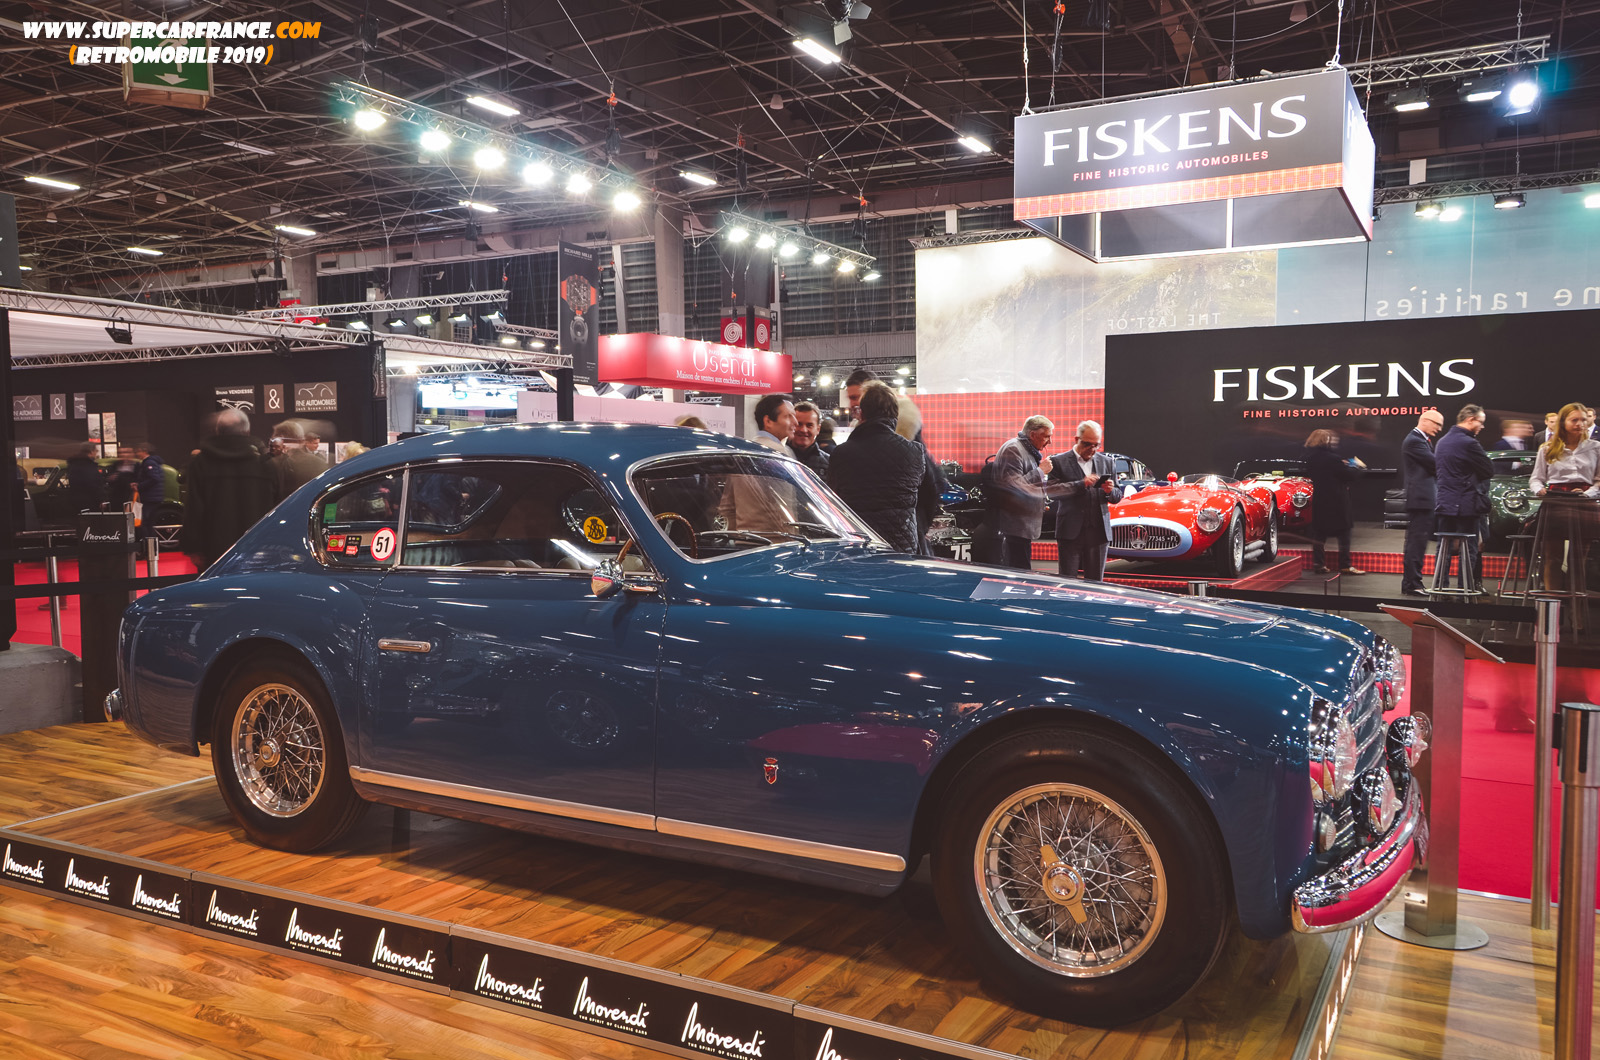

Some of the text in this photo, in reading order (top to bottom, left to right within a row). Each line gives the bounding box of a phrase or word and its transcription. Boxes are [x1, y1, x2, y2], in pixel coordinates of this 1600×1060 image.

[1043, 95, 1307, 166] FISKENS
[1073, 150, 1269, 182] FINE HISTORIC AUTOMOBILES
[676, 370, 694, 380] Maison
[744, 378, 759, 387] Auction
[760, 380, 771, 388] house
[1213, 358, 1476, 402] FISKENS
[54, 398, 63, 416] &
[268, 388, 280, 409] &
[1244, 410, 1271, 418] FINE
[1278, 408, 1339, 418] HISTORIC
[376, 537, 390, 553] 51
[614, 1023, 633, 1032] CLASSIC
